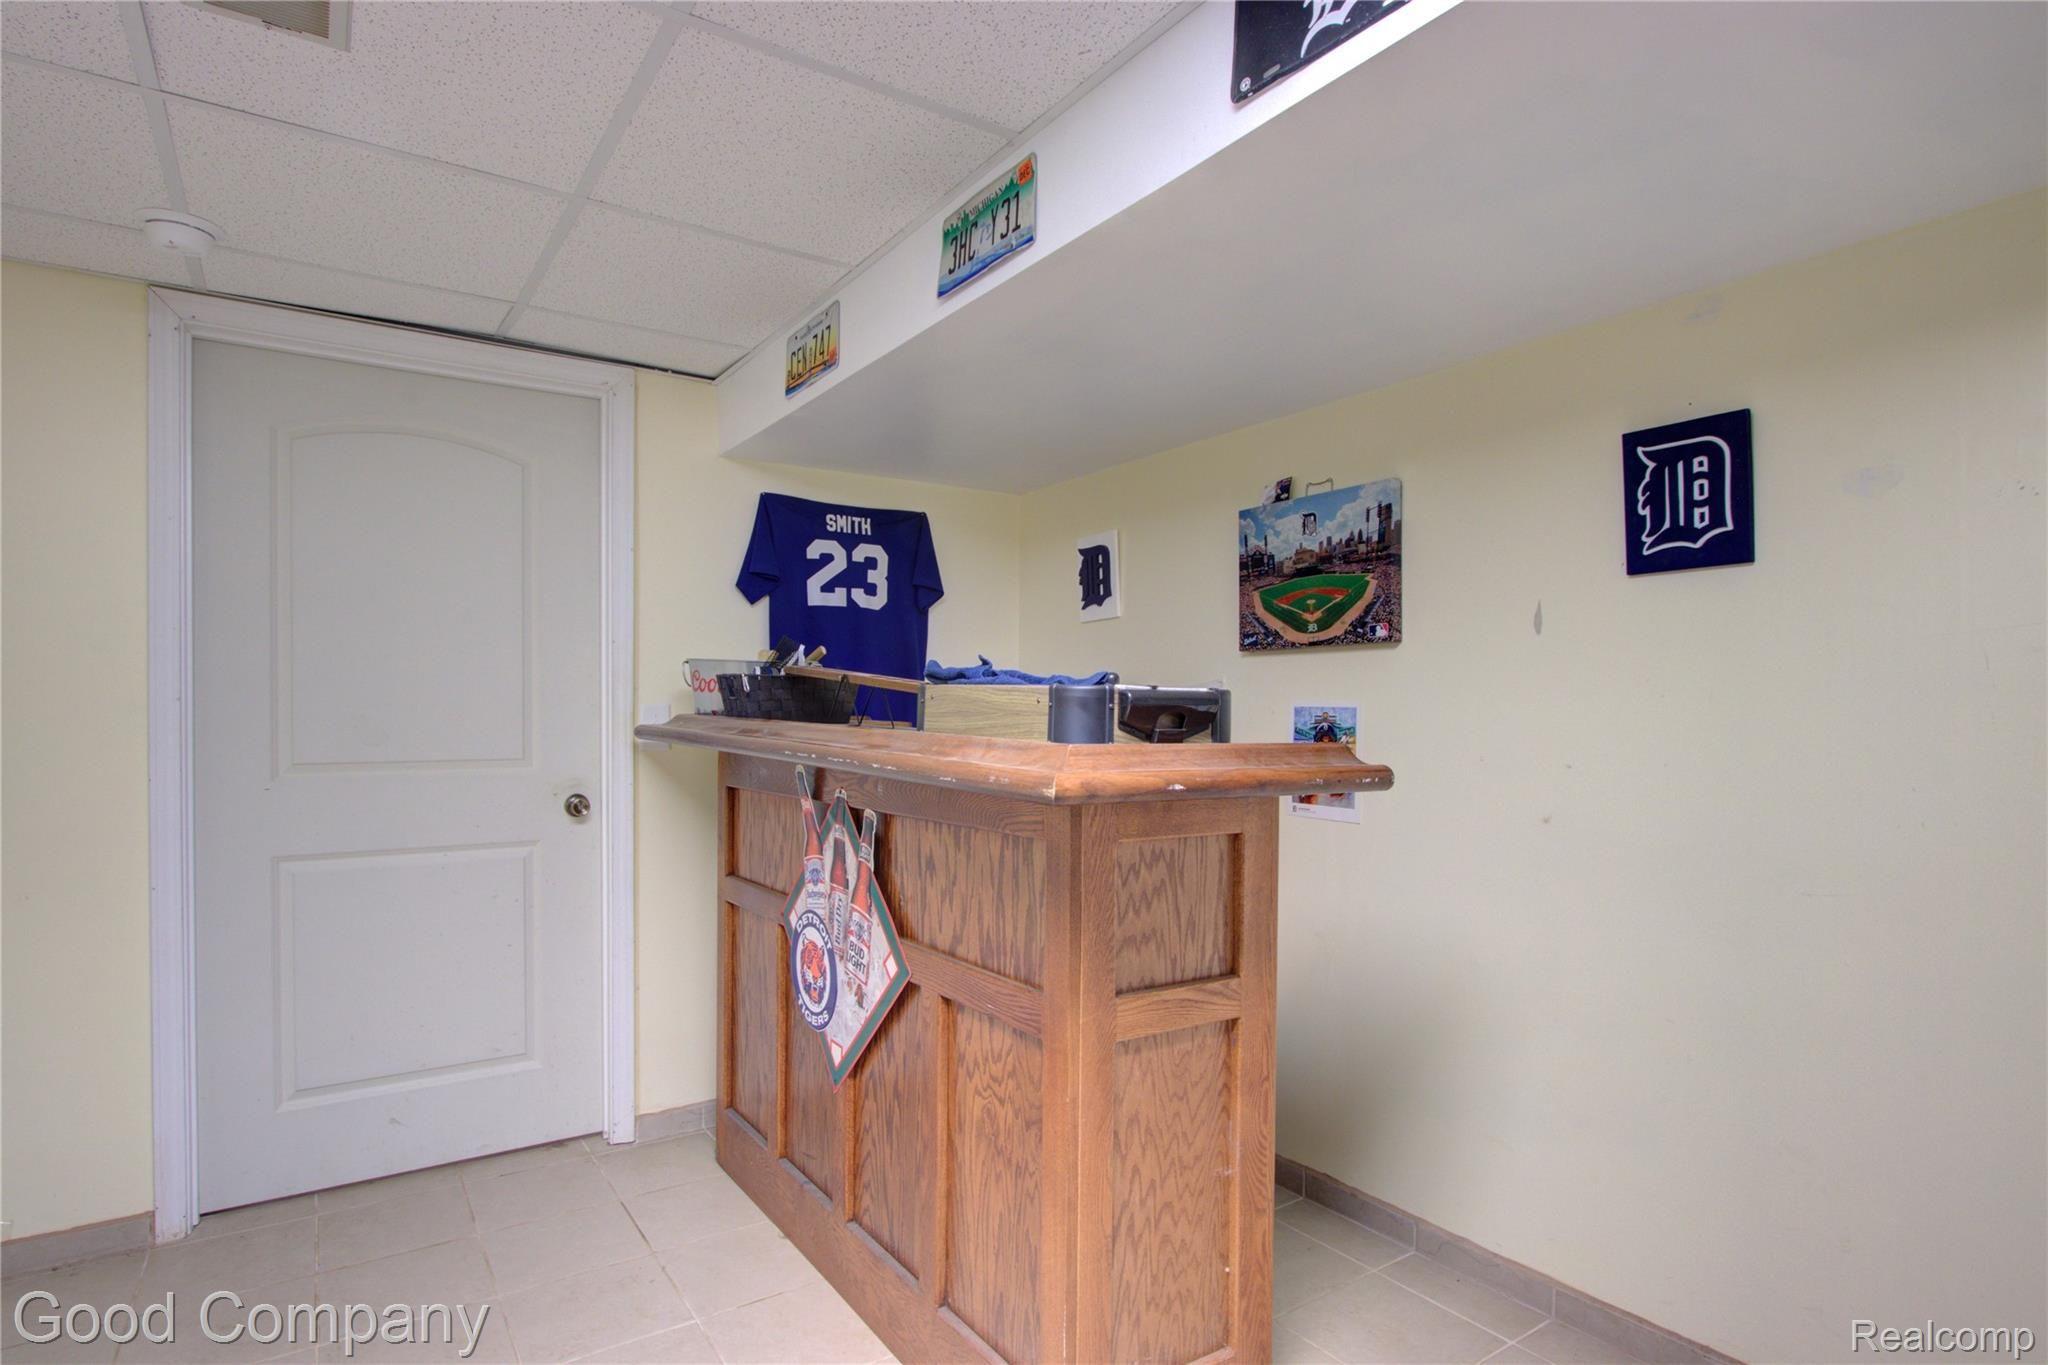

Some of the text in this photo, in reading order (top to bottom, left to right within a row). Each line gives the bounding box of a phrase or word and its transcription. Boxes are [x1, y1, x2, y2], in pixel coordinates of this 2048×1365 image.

[948, 191, 1022, 275] 3HC Y31
[813, 324, 831, 364] 747
[825, 513, 872, 536] SMITH
[806, 538, 889, 611] 23
[691, 669, 721, 693] Coo
[796, 913, 832, 950] DETROIT
[846, 951, 866, 975] LIGHT
[848, 940, 866, 961] BUD
[798, 993, 829, 1026] TIGERS
